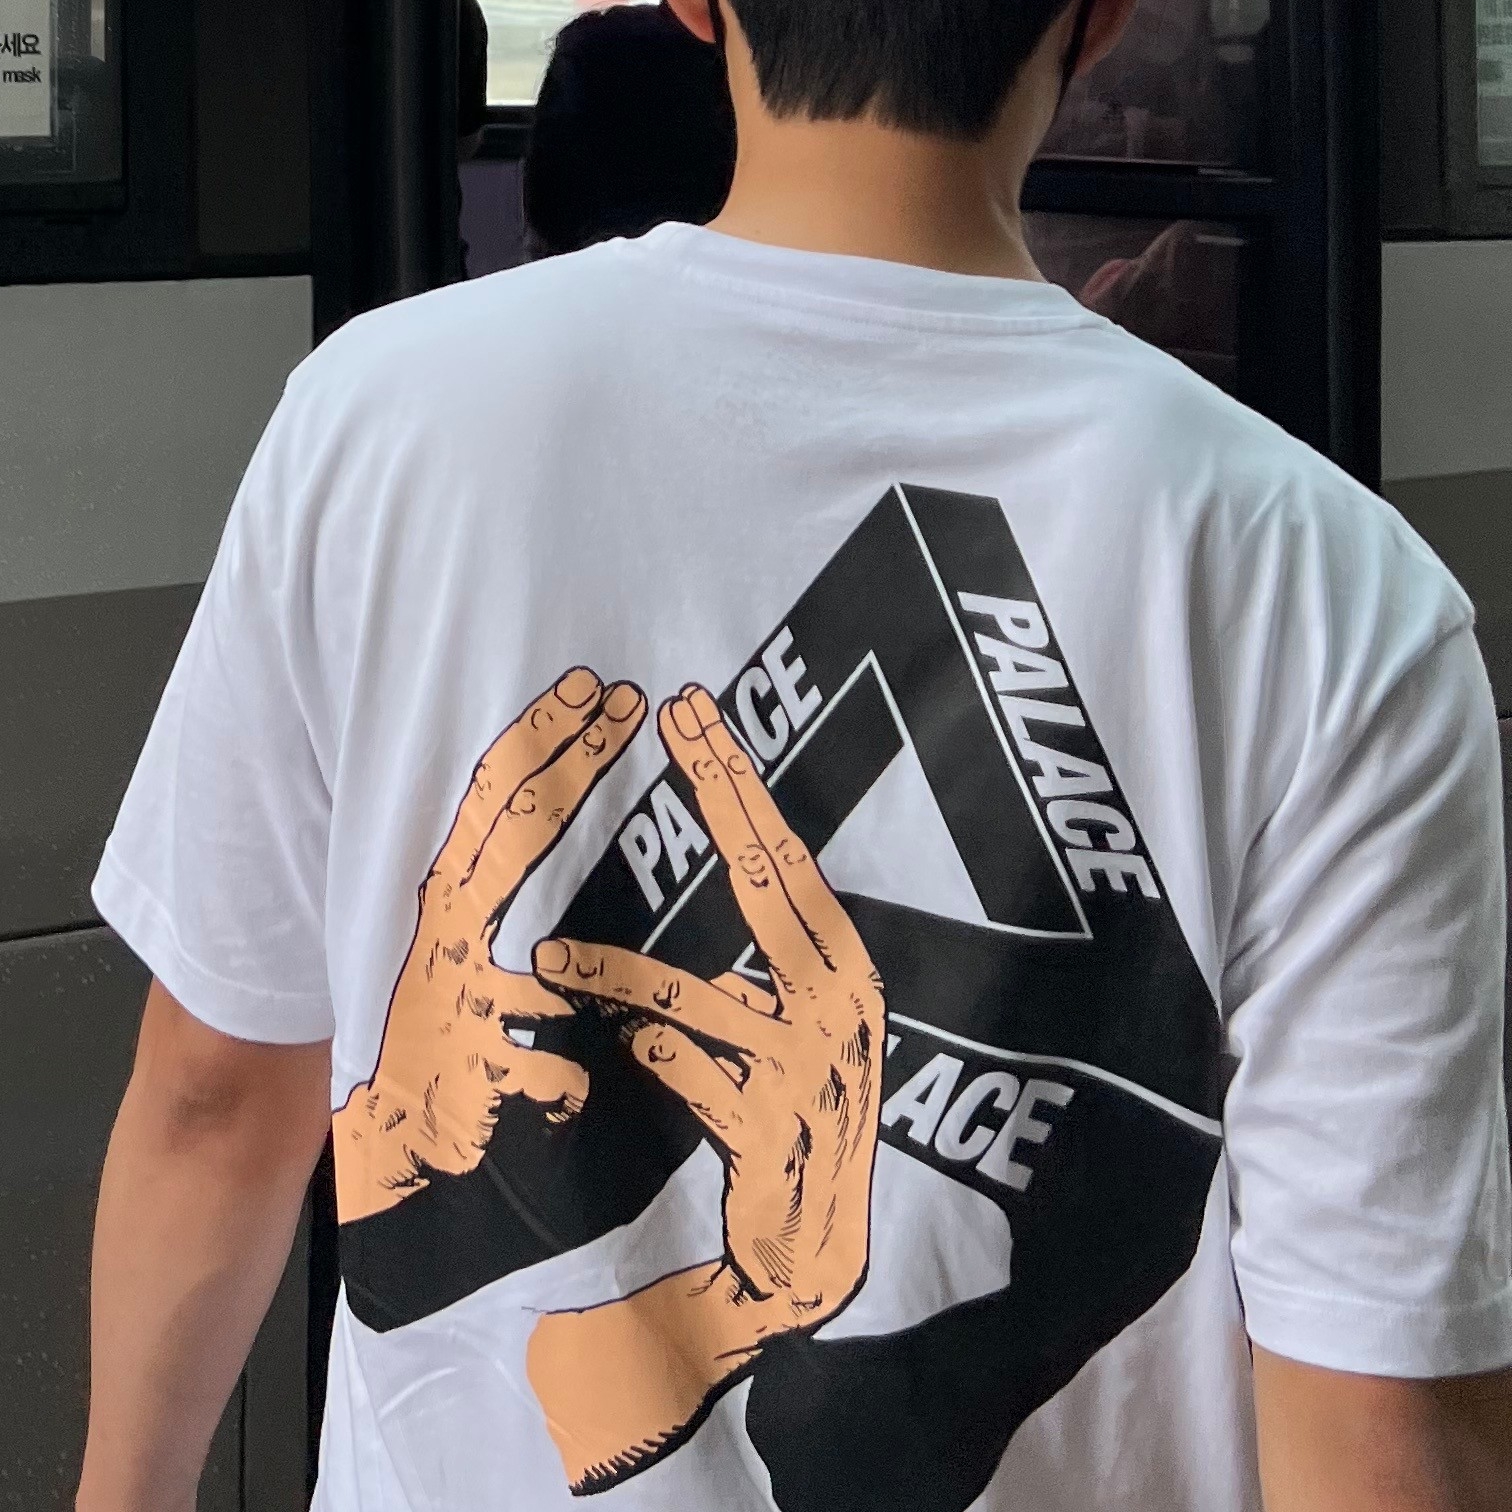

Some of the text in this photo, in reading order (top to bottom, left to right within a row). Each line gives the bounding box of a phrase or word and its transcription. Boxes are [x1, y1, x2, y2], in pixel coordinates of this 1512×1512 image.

[3, 66, 42, 83] mask
[618, 625, 823, 913] PACE
[957, 591, 1161, 900] PALACE
